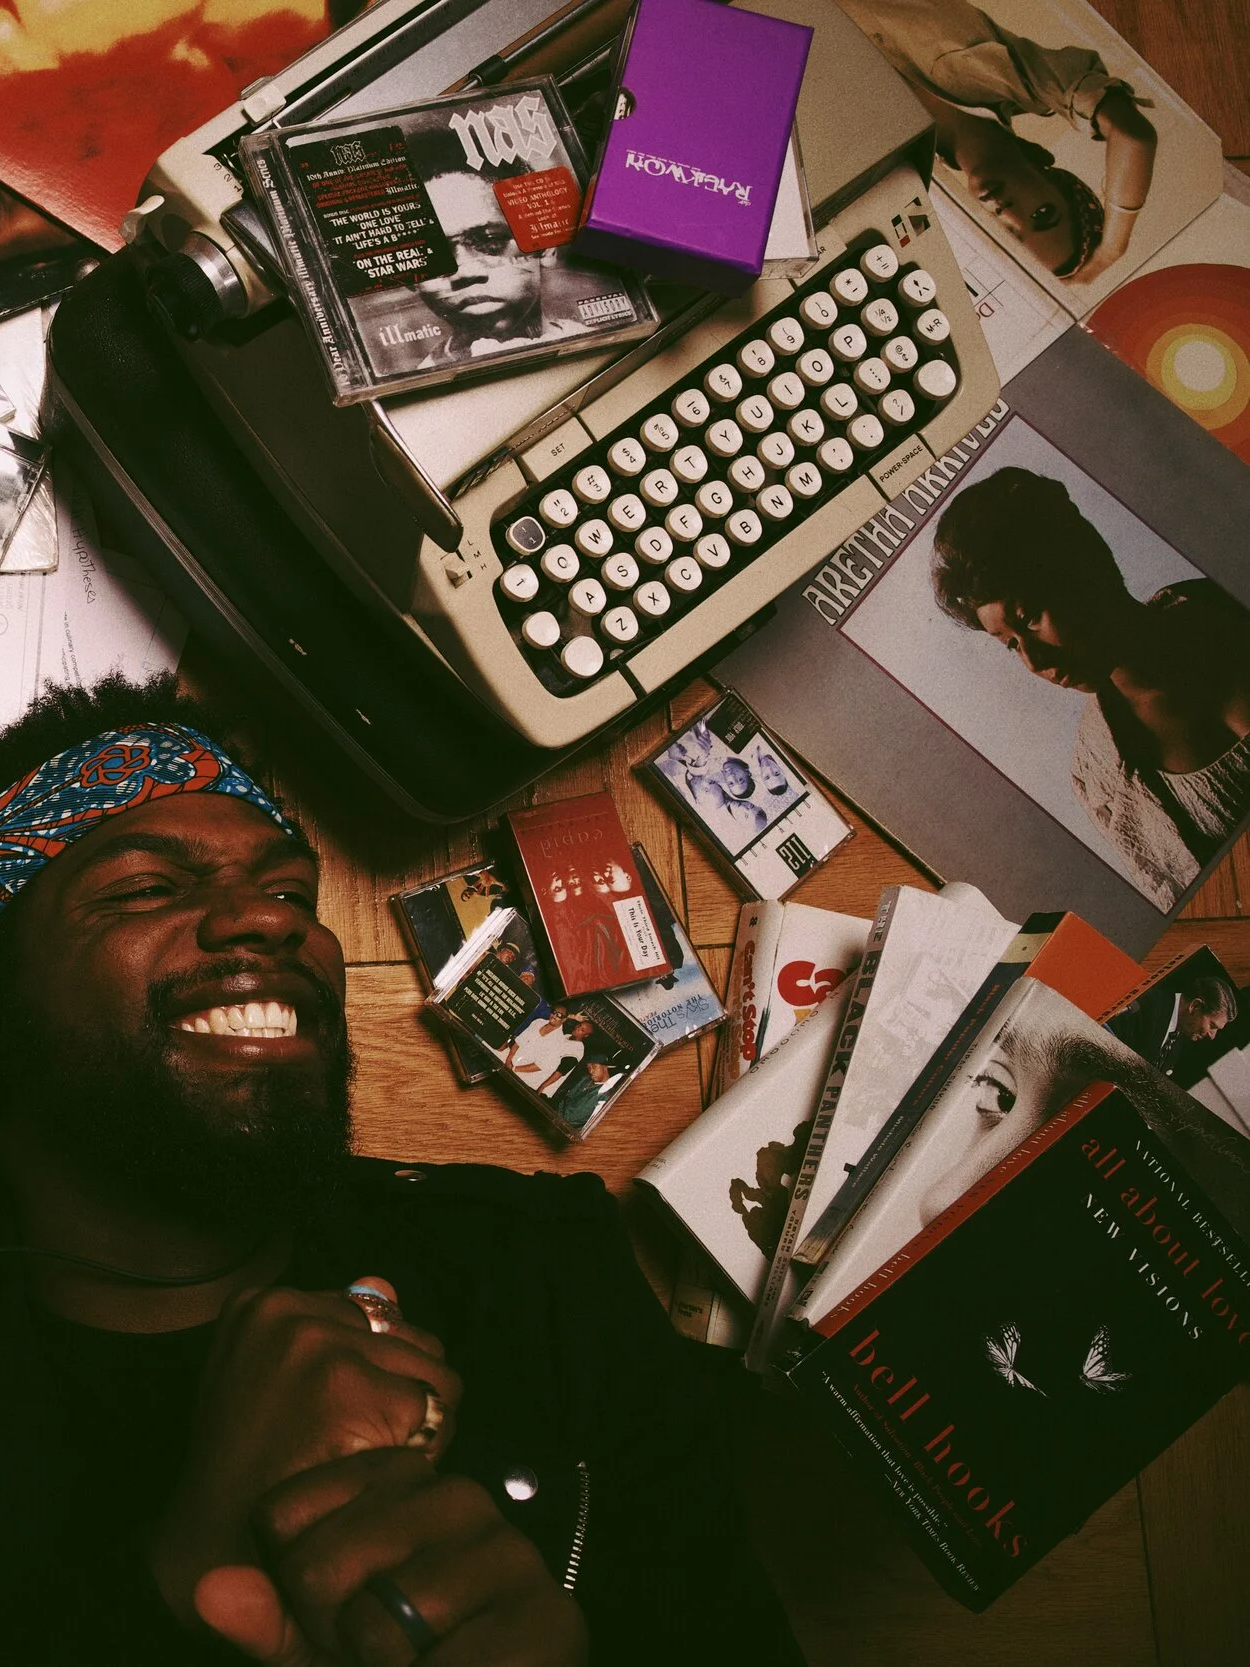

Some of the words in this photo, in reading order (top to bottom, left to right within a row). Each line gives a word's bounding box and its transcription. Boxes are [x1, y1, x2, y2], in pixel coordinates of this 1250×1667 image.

[506, 195, 528, 206] VIDEO
[351, 211, 379, 222] WORLD
[382, 208, 390, 216] IS
[345, 231, 366, 243] AIN'T
[368, 226, 393, 238] HARD
[394, 223, 405, 232] TO
[375, 253, 395, 265] THE
[582, 297, 627, 318] ADVISORY
[379, 322, 442, 347] illmatic
[549, 442, 567, 458] SET
[878, 444, 924, 483] POWER-SPACE
[801, 503, 916, 626] ARETHA
[64, 627, 76, 653] culinary
[627, 907, 638, 921] This
[873, 900, 891, 942] THE
[634, 928, 646, 944] Your
[639, 943, 651, 959] Day
[741, 940, 756, 1003] Can't
[682, 992, 702, 1007] THE
[648, 1012, 677, 1038] The
[829, 950, 883, 1079] BLACK
[740, 1004, 757, 1062] Stop
[1073, 1090, 1092, 1108] all
[1031, 1110, 1070, 1146] about
[794, 1085, 841, 1202] PANTHERS
[999, 1147, 1029, 1174] love
[1135, 1139, 1190, 1211] NATIONAL
[1081, 1139, 1126, 1180] all
[1120, 1187, 1200, 1277] about
[878, 1252, 911, 1279] bell
[1080, 1192, 1125, 1239] NEW
[1128, 1247, 1204, 1340] VISIONS
[830, 1283, 877, 1319] hooks
[828, 1383, 847, 1407] warm
[845, 1402, 881, 1451] affirmation
[880, 1447, 895, 1467] that
[893, 1463, 909, 1487] love
[848, 1328, 931, 1422] bell
[924, 1423, 1028, 1558] hooks
[903, 1496, 921, 1521] YORK
[920, 1518, 941, 1545] TIMES
[938, 1540, 957, 1566] BOOK
[955, 1561, 981, 1593] REVIEW
